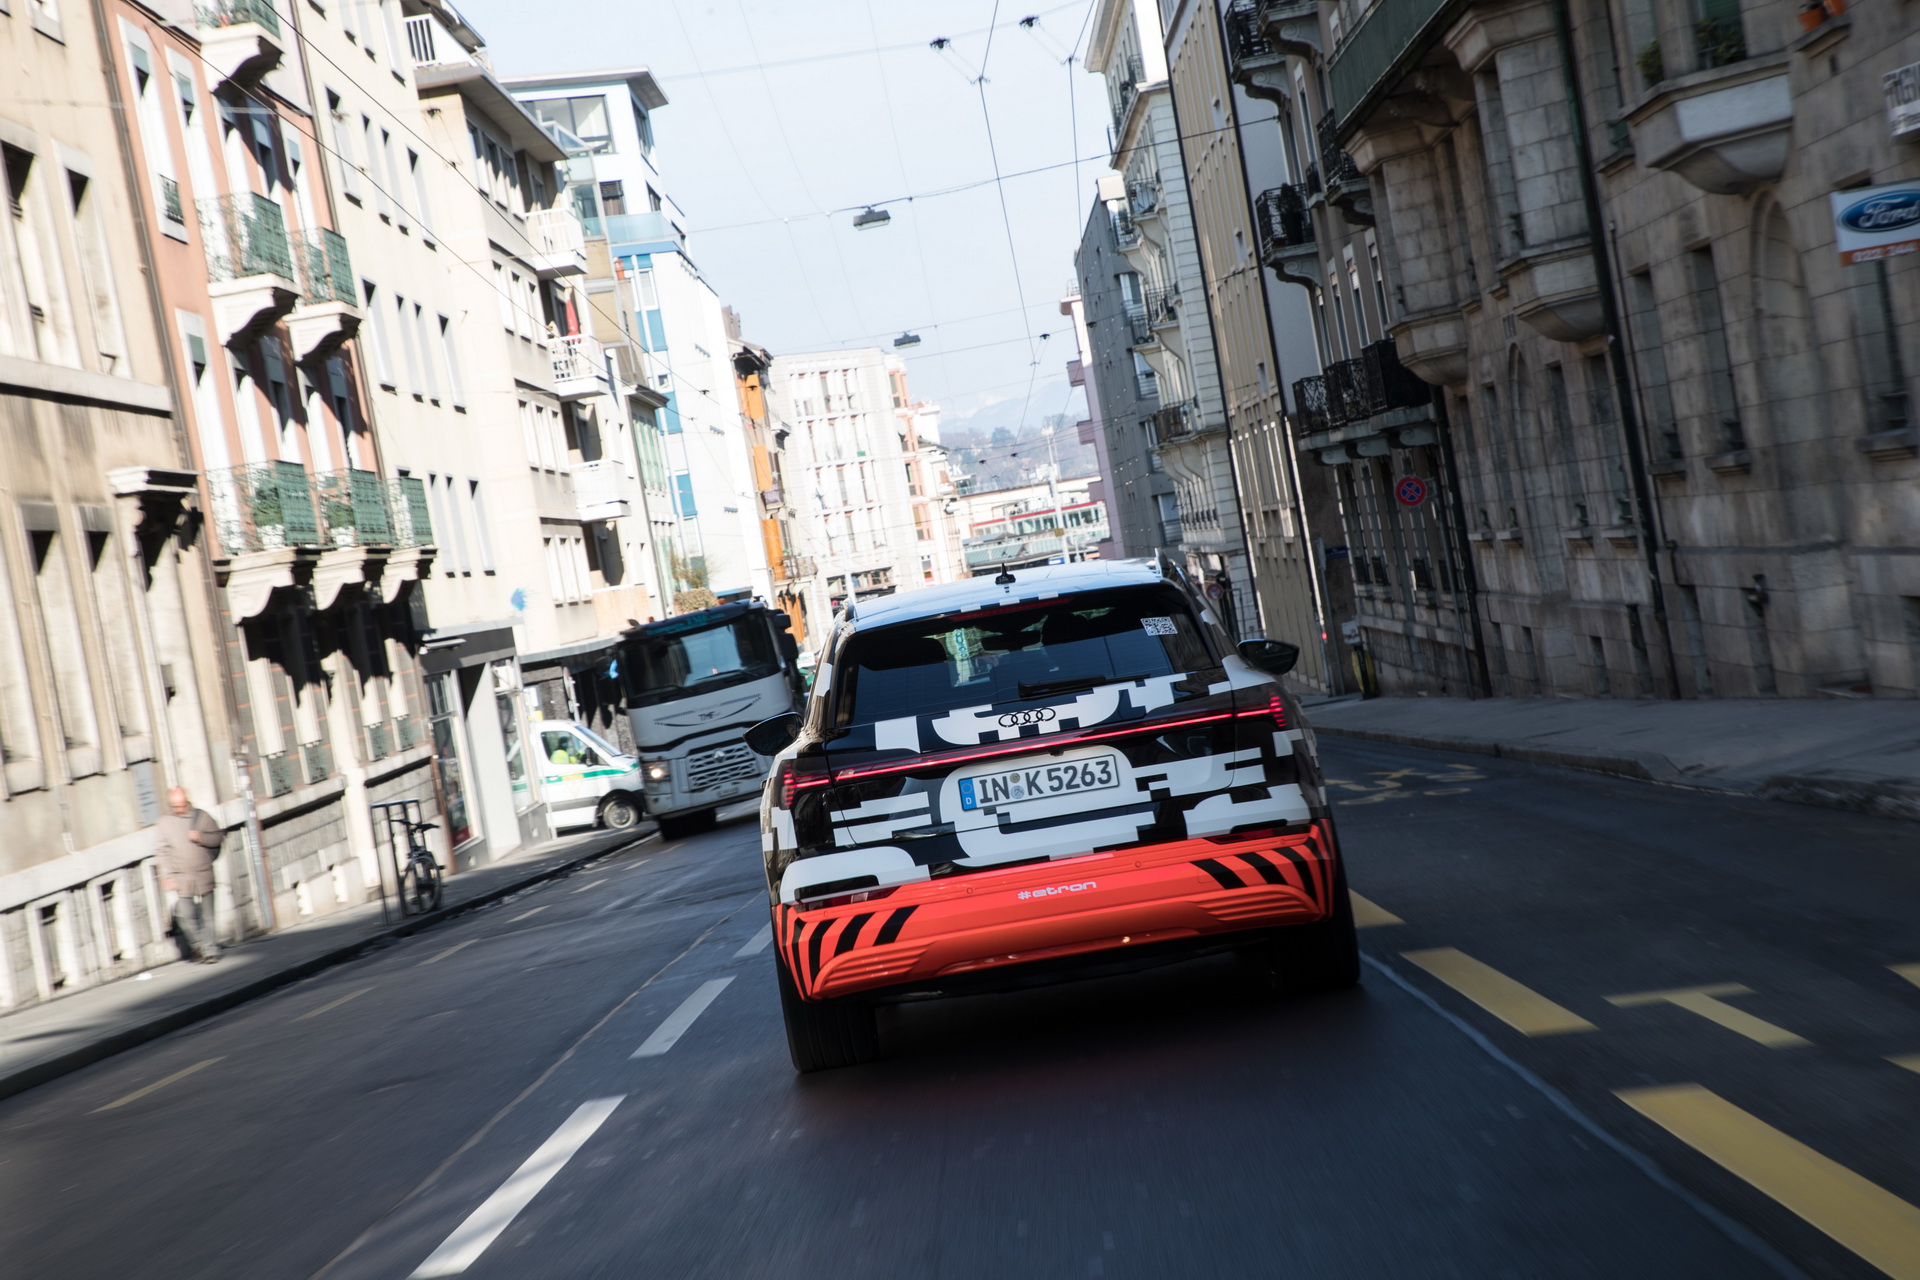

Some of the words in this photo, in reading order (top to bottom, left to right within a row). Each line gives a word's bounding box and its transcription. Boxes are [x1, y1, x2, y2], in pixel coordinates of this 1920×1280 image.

[1858, 197, 1920, 228] Ford
[965, 797, 973, 805] D
[979, 776, 1010, 804] IN
[1047, 760, 1112, 792] 5263
[1017, 881, 1097, 900] #etron
